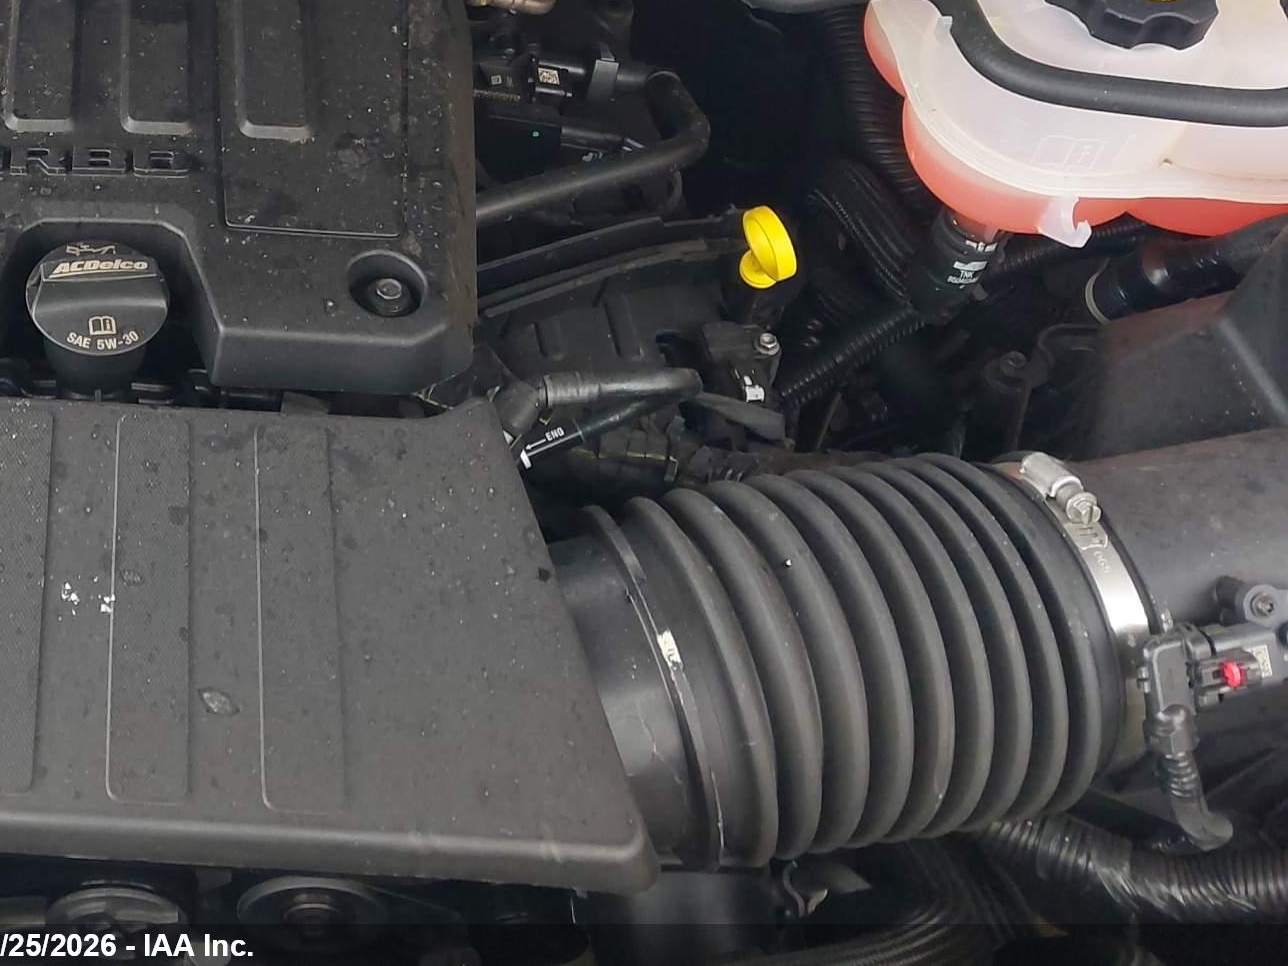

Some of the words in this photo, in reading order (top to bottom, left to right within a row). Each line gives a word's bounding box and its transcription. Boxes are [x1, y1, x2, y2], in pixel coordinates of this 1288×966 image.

[53, 259, 148, 274] ACDelco
[66, 331, 91, 349] SAE
[97, 330, 140, 350] 5W-30
